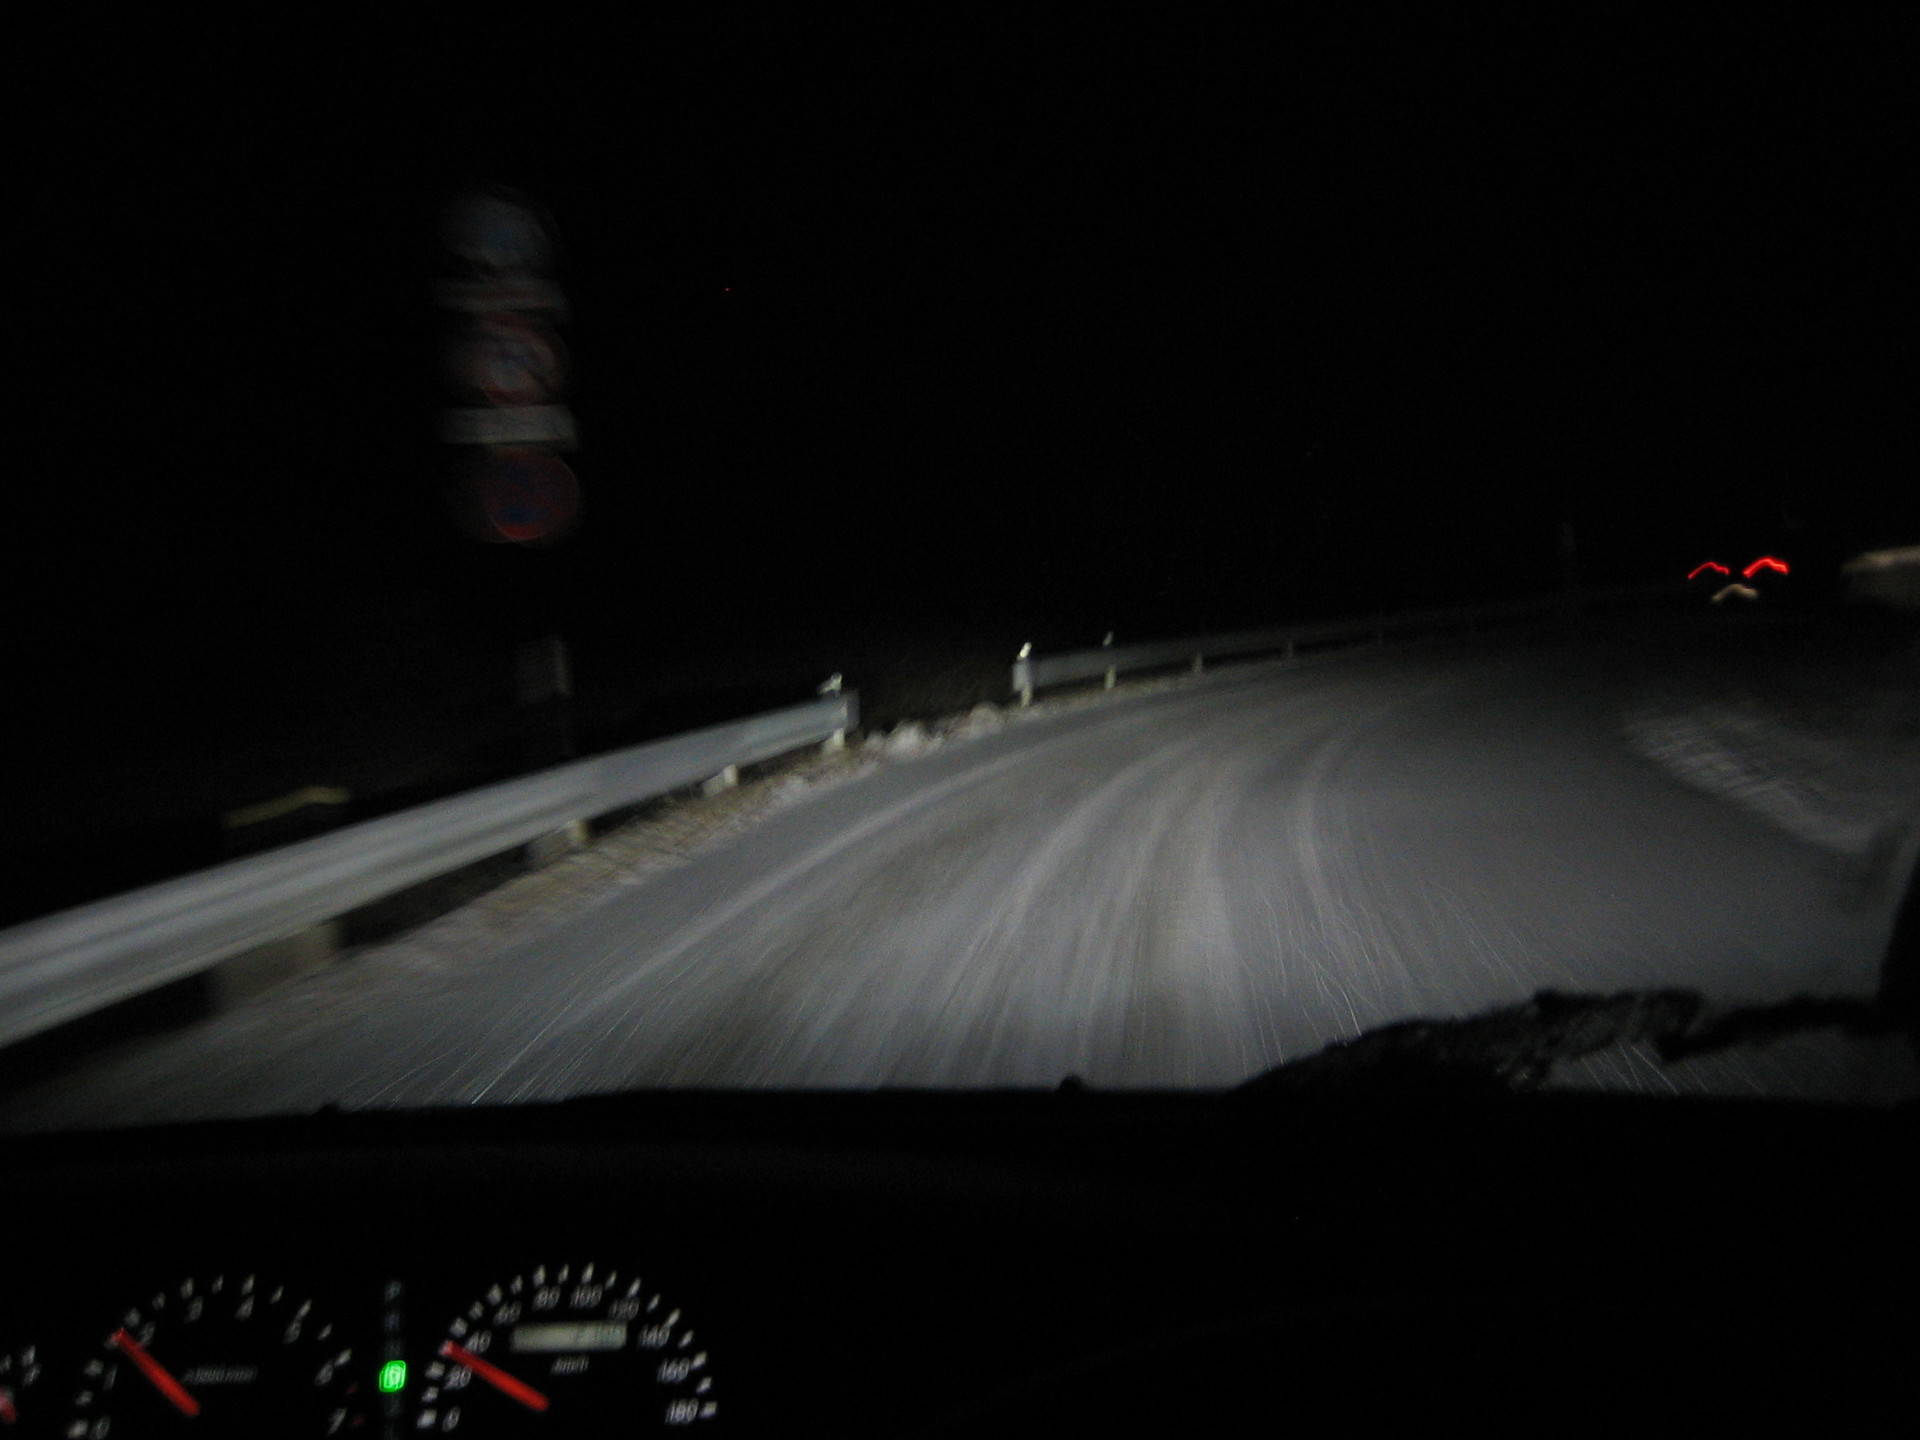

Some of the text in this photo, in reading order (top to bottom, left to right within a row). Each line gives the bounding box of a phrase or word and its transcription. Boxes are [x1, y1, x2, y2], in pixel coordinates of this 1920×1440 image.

[465, 1332, 491, 1355] 40
[640, 1326, 670, 1348] 140
[444, 1365, 473, 1390] 20
[659, 1359, 689, 1383] 160
[443, 1408, 460, 1431] 0
[667, 1400, 698, 1424] 180
